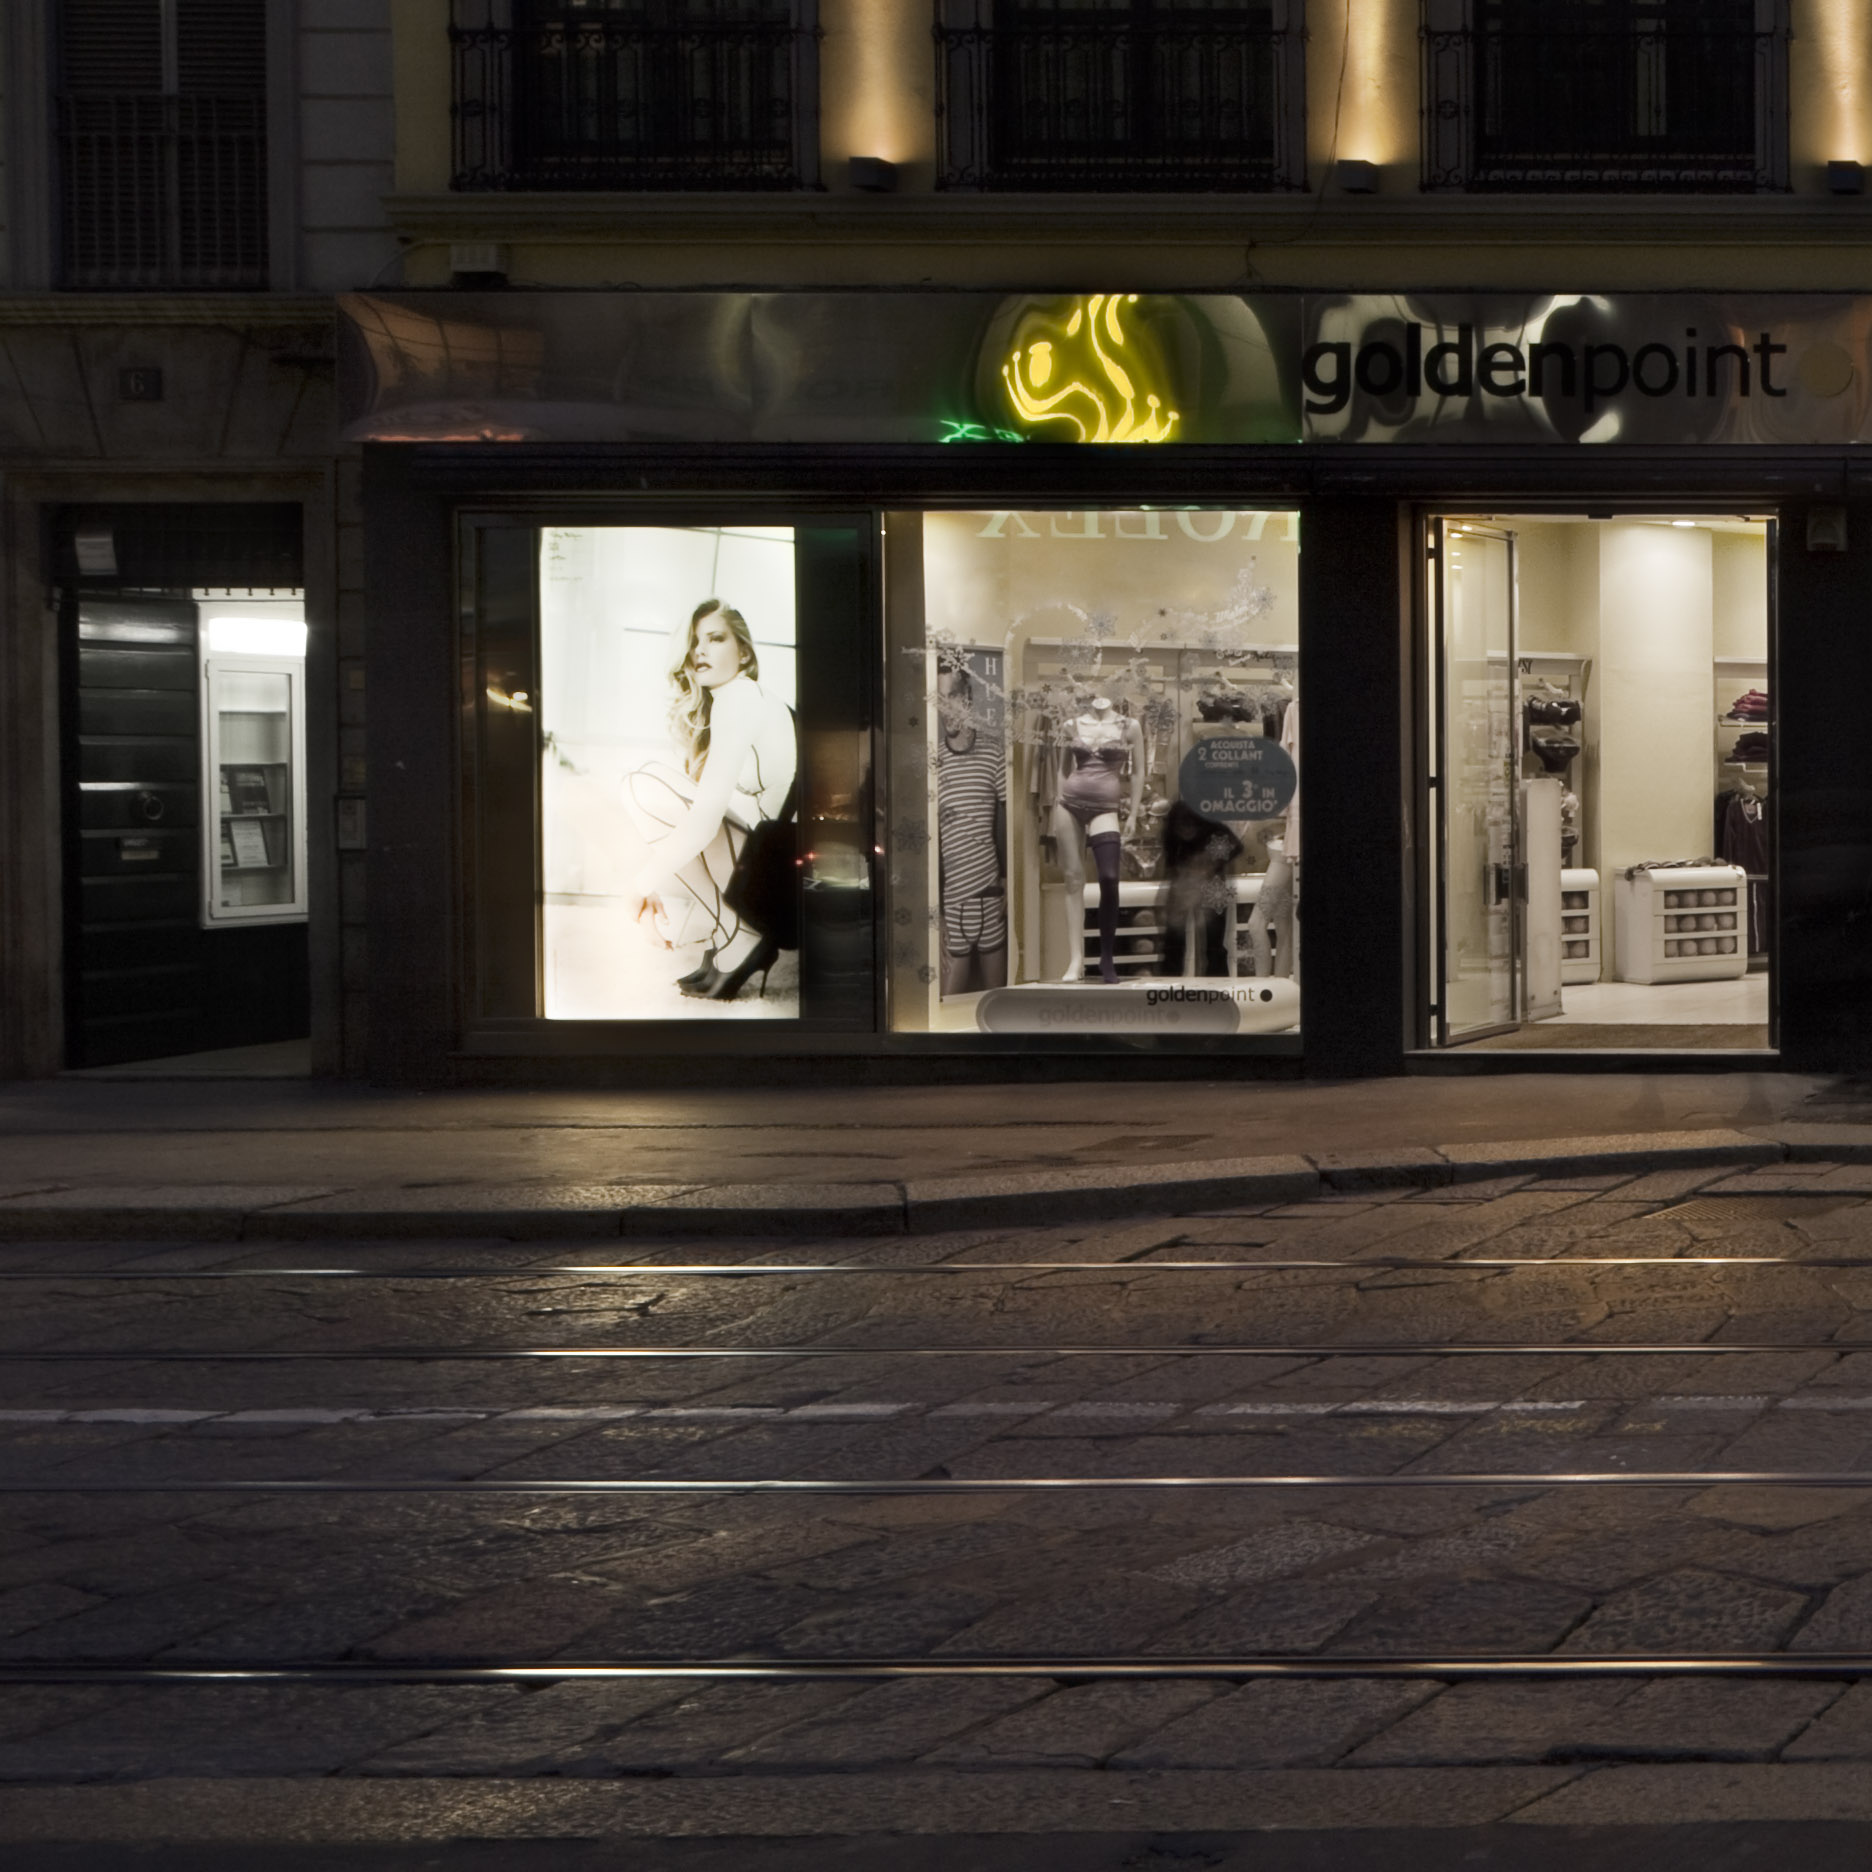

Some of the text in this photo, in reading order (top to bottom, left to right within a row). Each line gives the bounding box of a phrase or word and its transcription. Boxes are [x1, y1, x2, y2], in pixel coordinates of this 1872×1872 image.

[1302, 322, 1787, 415] goldenpoint
[1210, 740, 1256, 749] ACQUISTA
[1197, 747, 1263, 761] 2 COLLANT
[1223, 787, 1235, 799] IL
[1262, 787, 1275, 799] IN
[1146, 986, 1255, 1005] goldenpoint
[1038, 1005, 1165, 1027] goldenpoint
